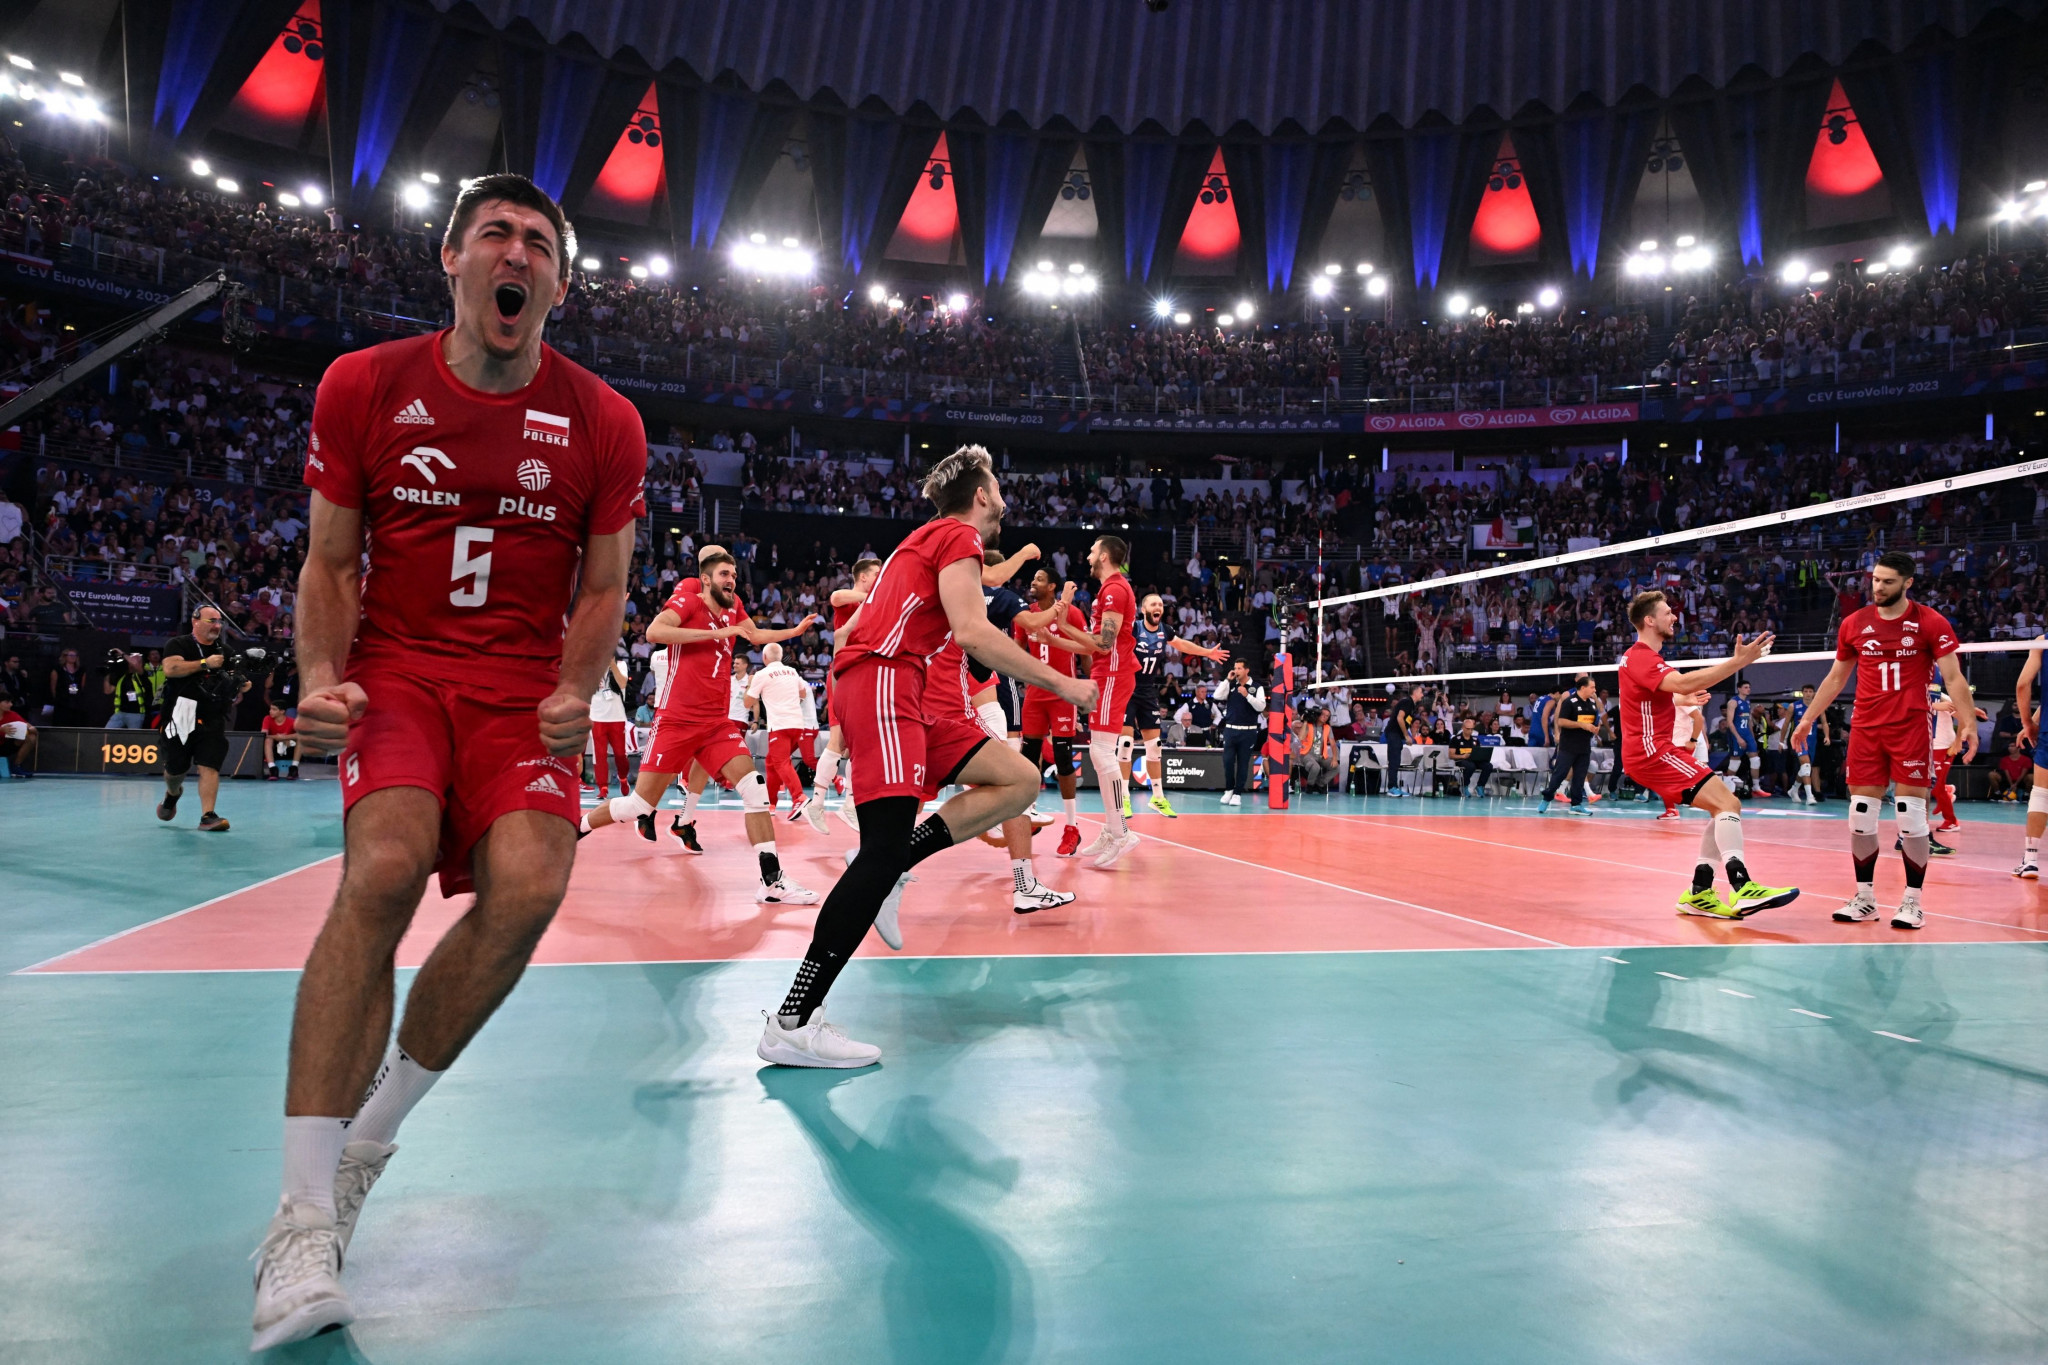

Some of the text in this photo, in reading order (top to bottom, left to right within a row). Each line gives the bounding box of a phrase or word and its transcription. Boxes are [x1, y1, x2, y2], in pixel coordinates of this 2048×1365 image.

[16, 263, 48, 279] CEV
[53, 270, 132, 299] EuroVolley
[660, 382, 686, 393] 2023
[1807, 380, 1940, 403] CEV EuroVolley 2023
[393, 414, 435, 426] adidas
[945, 409, 1044, 425] CEV EuroVolley 2023
[1487, 413, 1536, 425] ALGIDA
[1580, 408, 1631, 421] ALGIDA
[1399, 417, 1446, 428] ALGIDA
[523, 430, 569, 447] POLSKA
[2018, 463, 2031, 473] CEV
[392, 486, 461, 506] ORLEN
[498, 496, 557, 521] plus
[449, 525, 495, 608] 5
[69, 590, 87, 599] CEV
[88, 592, 130, 603] EuroVolley
[131, 595, 151, 603] 2023
[1040, 643, 1049, 664] 9
[1896, 648, 1918, 658] plus
[711, 650, 723, 678] 7
[1142, 656, 1157, 675] 17
[768, 668, 796, 679] POLSKA
[1878, 661, 1900, 691] 11
[101, 743, 158, 765] 1996
[656, 753, 663, 767] 7
[346, 752, 360, 787] 5
[1166, 758, 1183, 767] CEV
[1166, 767, 1206, 779] EuroVolley
[1166, 776, 1185, 784] 2023
[524, 785, 566, 798] adidas
